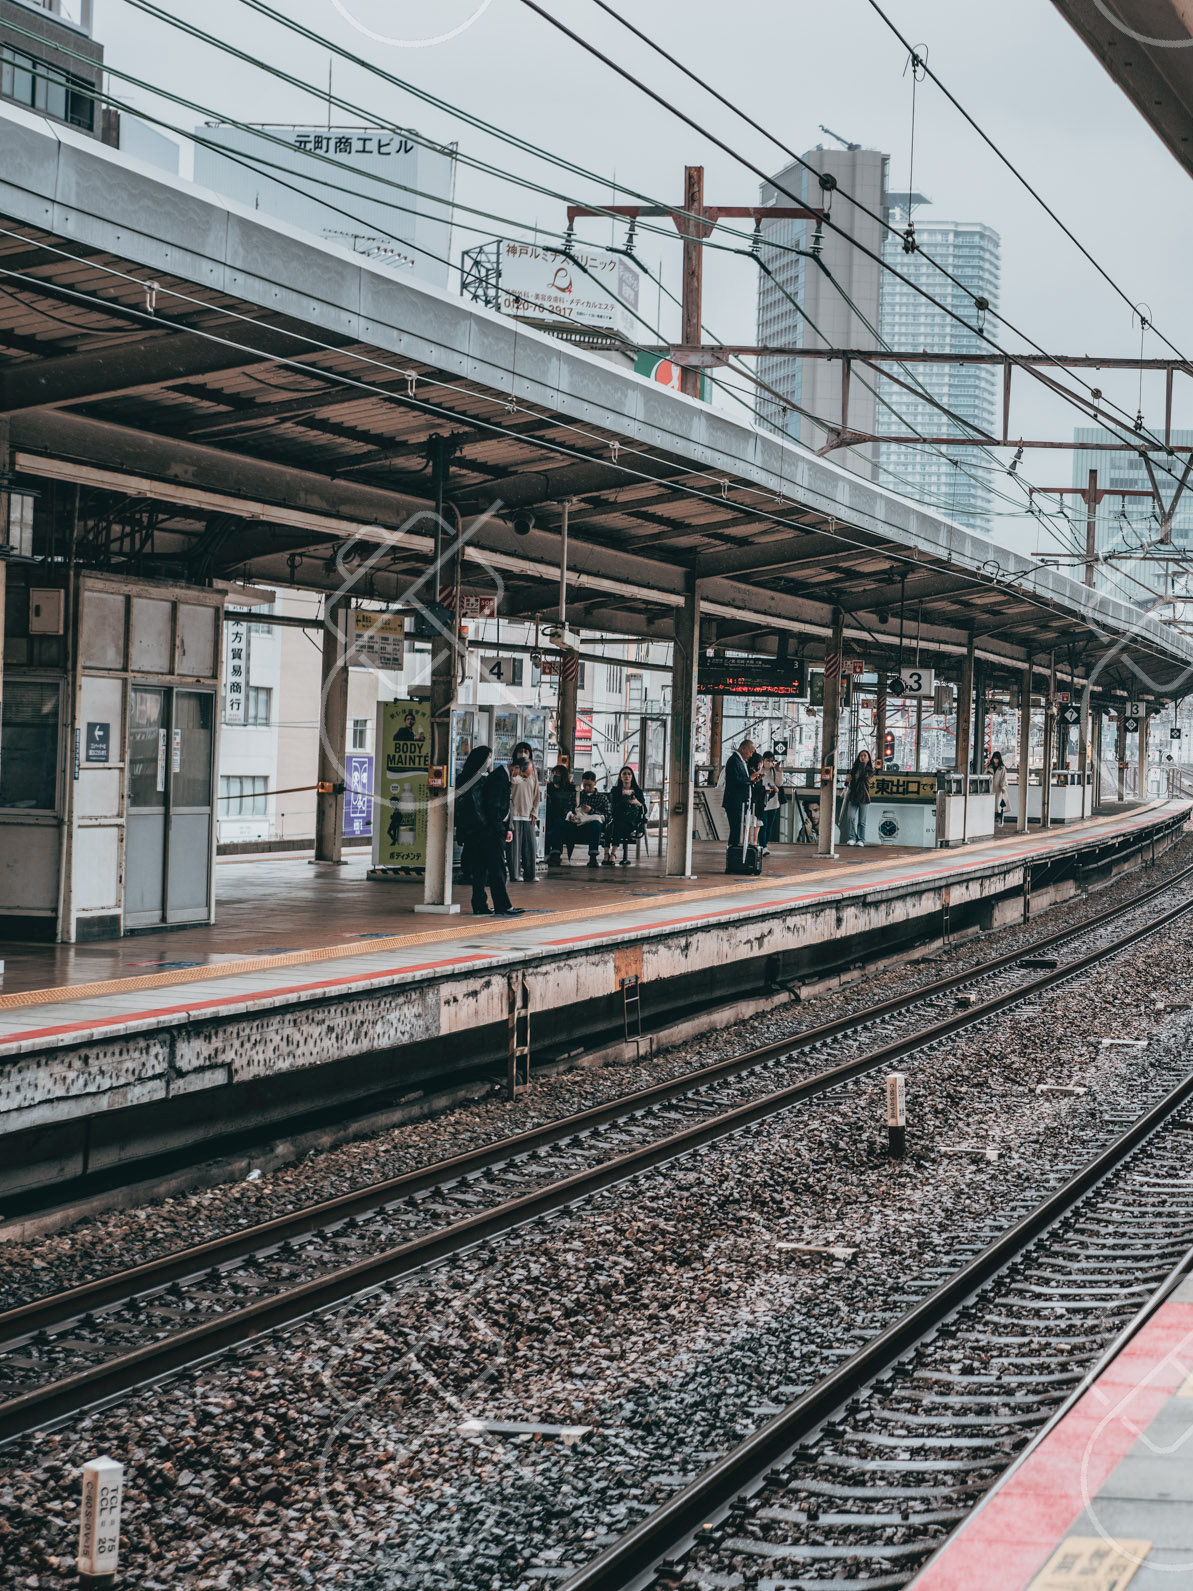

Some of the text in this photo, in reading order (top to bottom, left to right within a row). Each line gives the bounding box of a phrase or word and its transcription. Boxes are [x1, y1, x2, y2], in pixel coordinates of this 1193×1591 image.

[294, 134, 414, 155] 元町商工ビル
[489, 661, 503, 681] 4
[793, 661, 799, 669] 3
[908, 672, 922, 692] 3
[1132, 704, 1140, 715] 3
[394, 742, 424, 754] BODY
[389, 852, 422, 862] ボディメンテ
[100, 1487, 109, 1516] CCL
[109, 1485, 119, 1514] TCL
[97, 1537, 106, 1555] 20
[107, 1536, 116, 1553] 75
